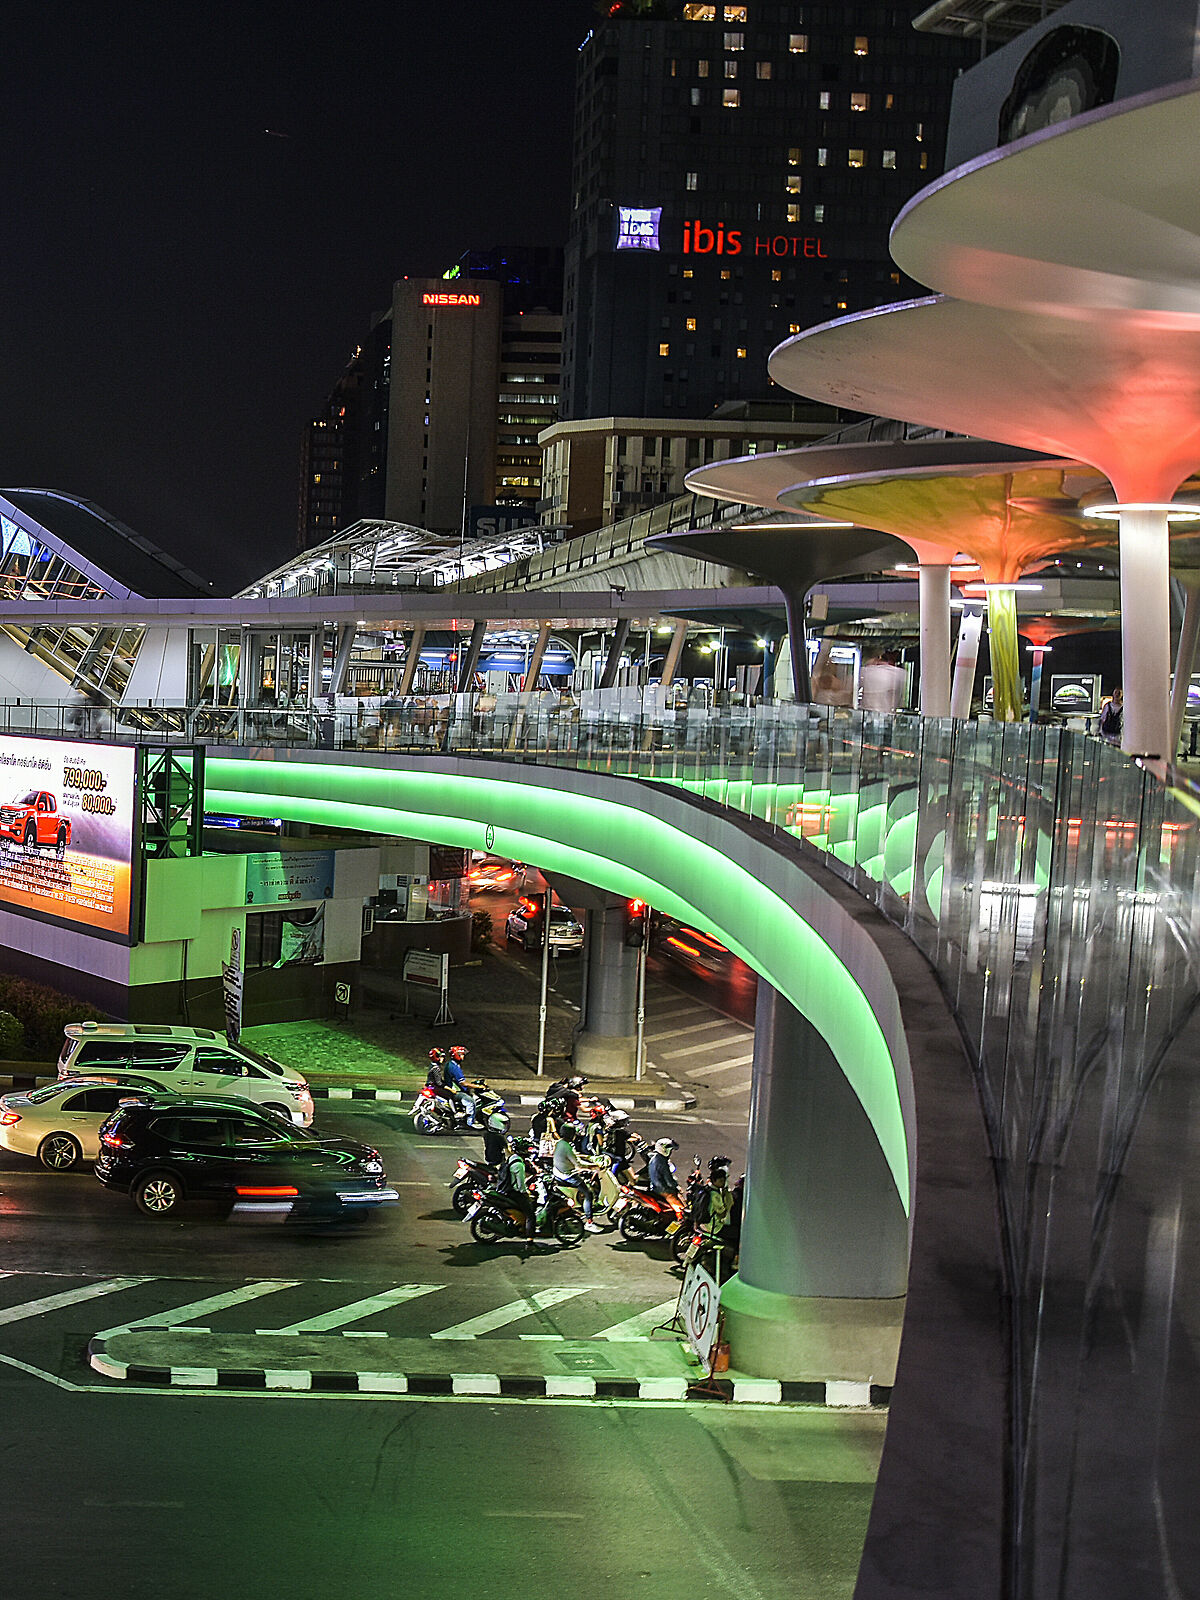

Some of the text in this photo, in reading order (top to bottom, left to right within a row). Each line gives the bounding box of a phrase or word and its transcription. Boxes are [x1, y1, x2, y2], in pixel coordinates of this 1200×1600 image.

[682, 219, 829, 259] ibis HOTEL
[422, 293, 481, 306] NISSAN
